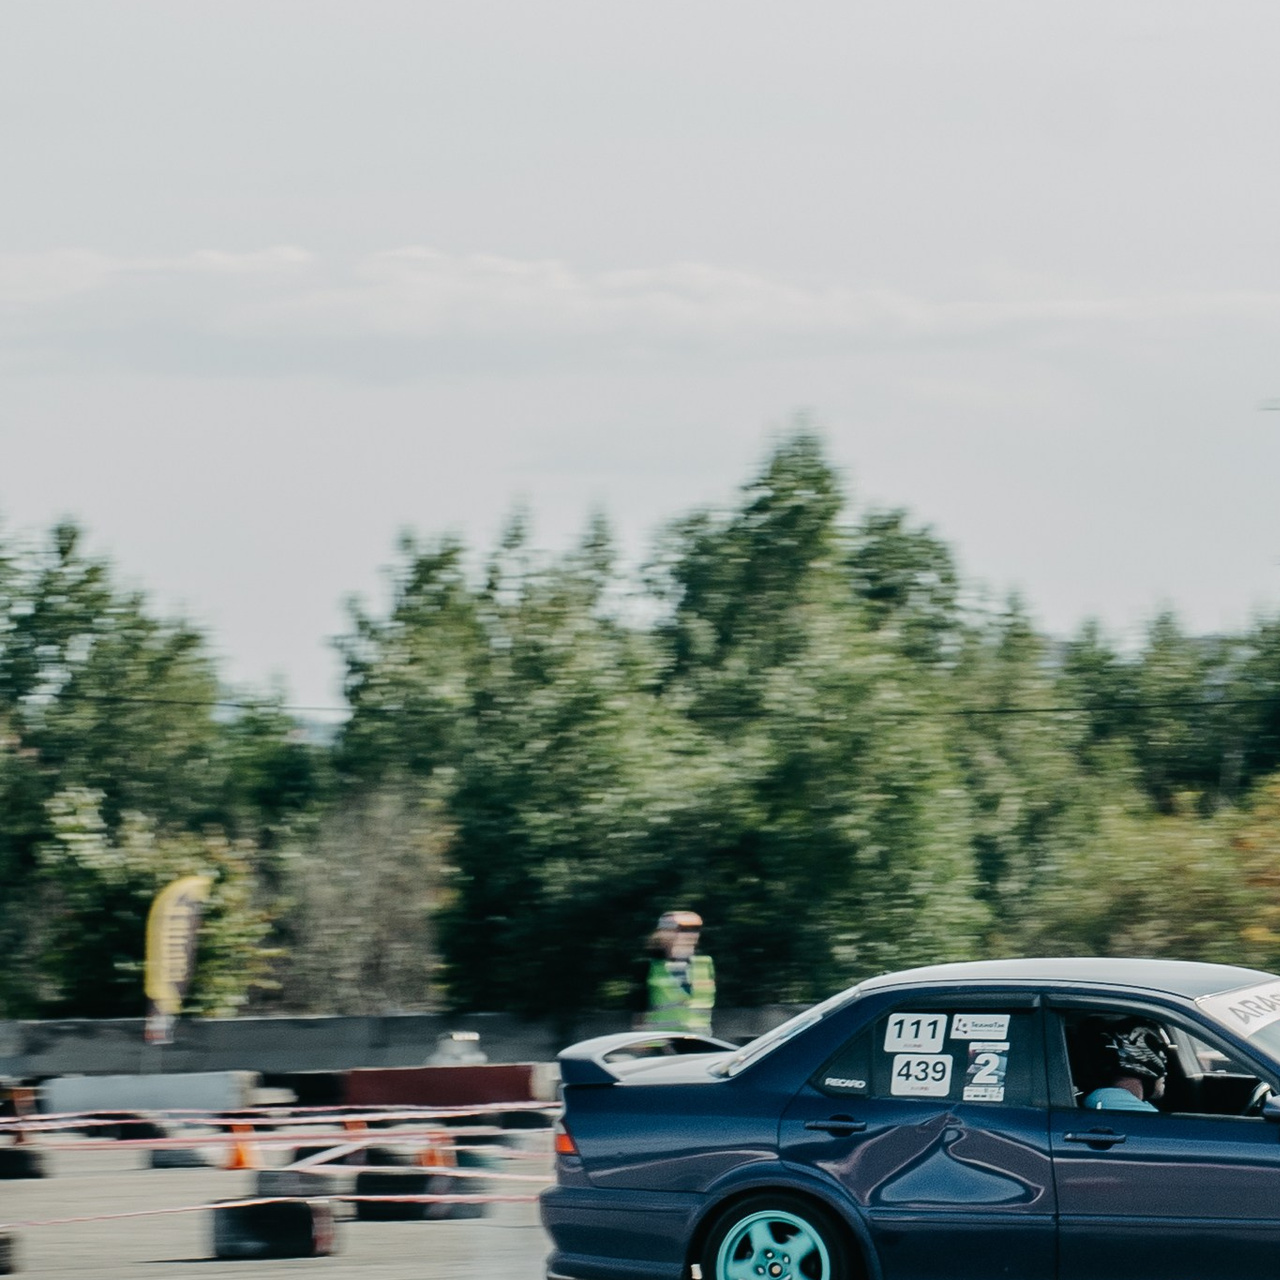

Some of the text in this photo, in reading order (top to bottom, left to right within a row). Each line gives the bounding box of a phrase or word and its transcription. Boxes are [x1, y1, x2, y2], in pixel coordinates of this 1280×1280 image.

[893, 1019, 939, 1039] 111
[897, 1060, 946, 1082] 439
[971, 1052, 1000, 1084] 2
